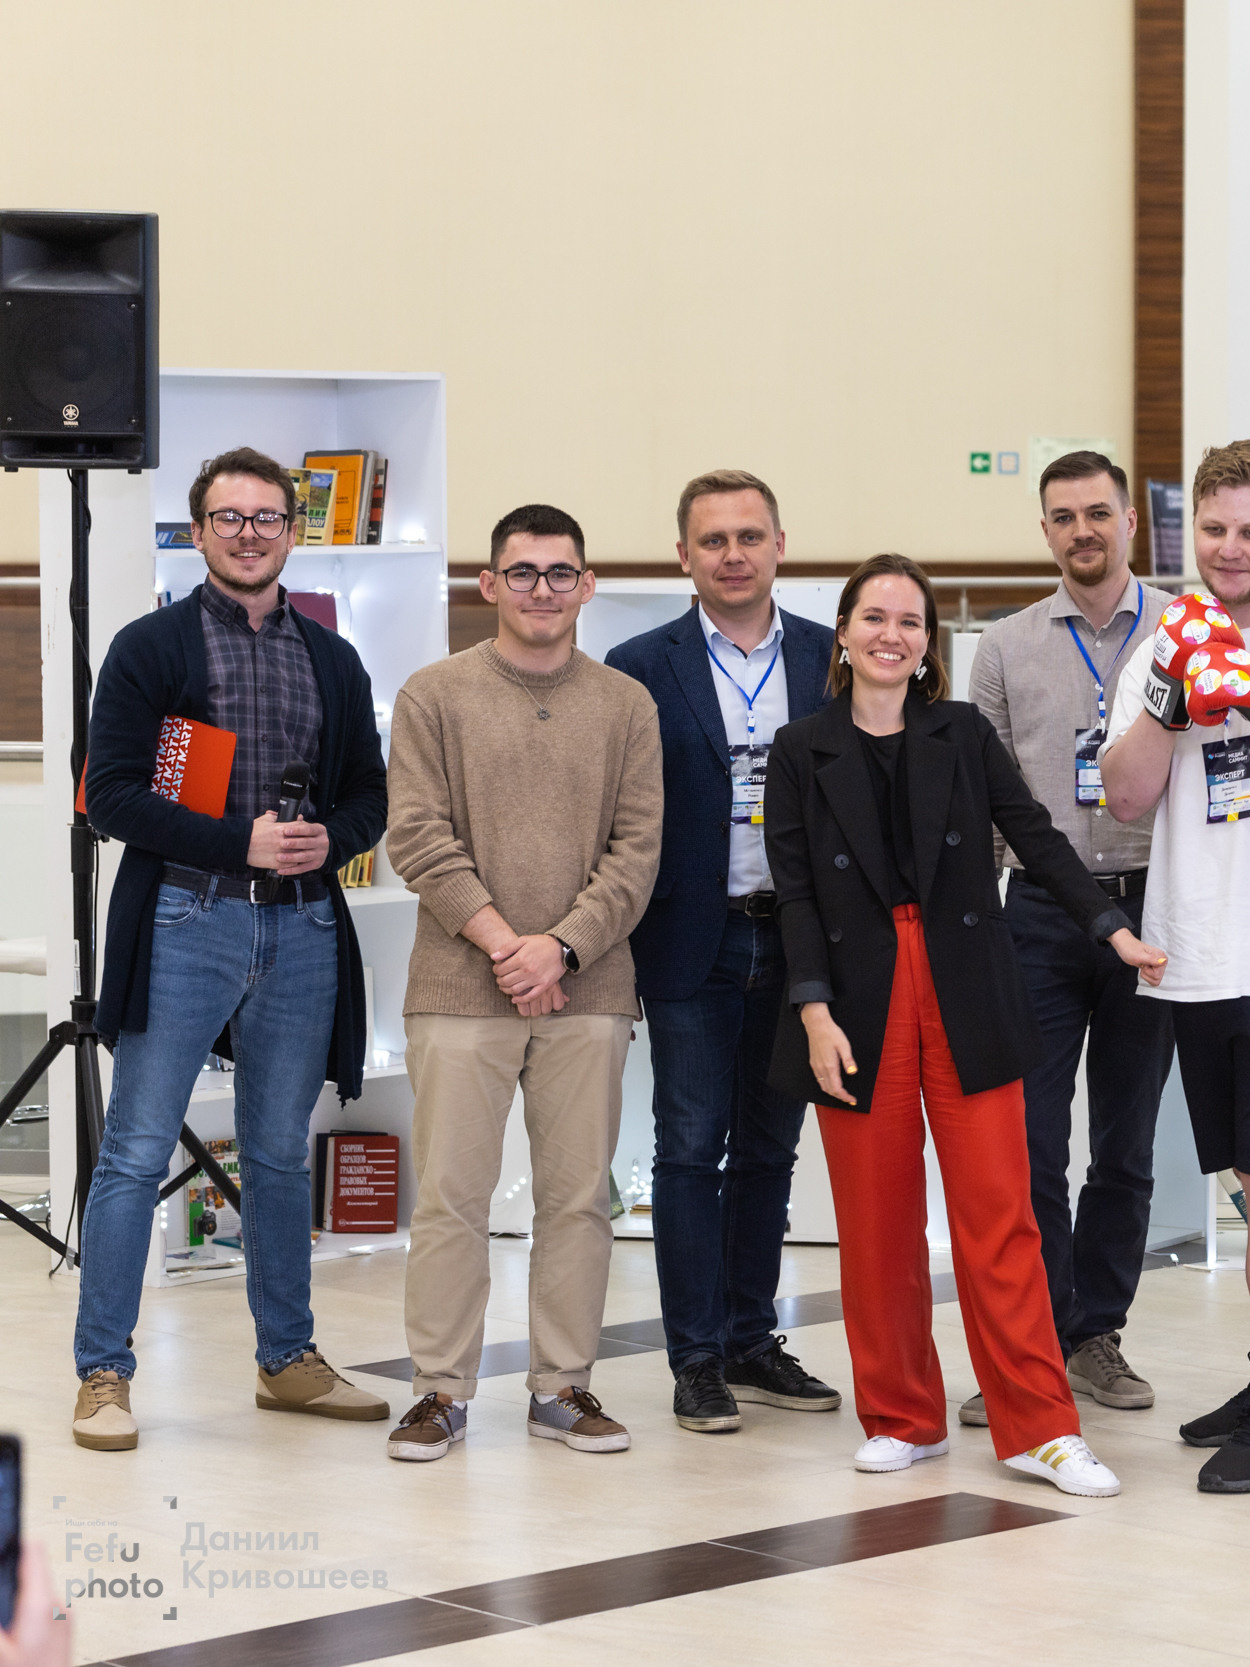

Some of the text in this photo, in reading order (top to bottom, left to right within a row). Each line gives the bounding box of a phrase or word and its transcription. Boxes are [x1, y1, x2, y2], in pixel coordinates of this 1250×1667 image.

[736, 775, 766, 783] ЭКСПЕР
[1214, 769, 1246, 782] ЭКСПЕРТ
[340, 1144, 365, 1153] СБОРНИК
[340, 1155, 367, 1164] ОБРАЗЦОВ
[340, 1176, 368, 1185] ПРАВОВЫХ
[339, 1187, 375, 1197] ДОКУМЕНТОВ
